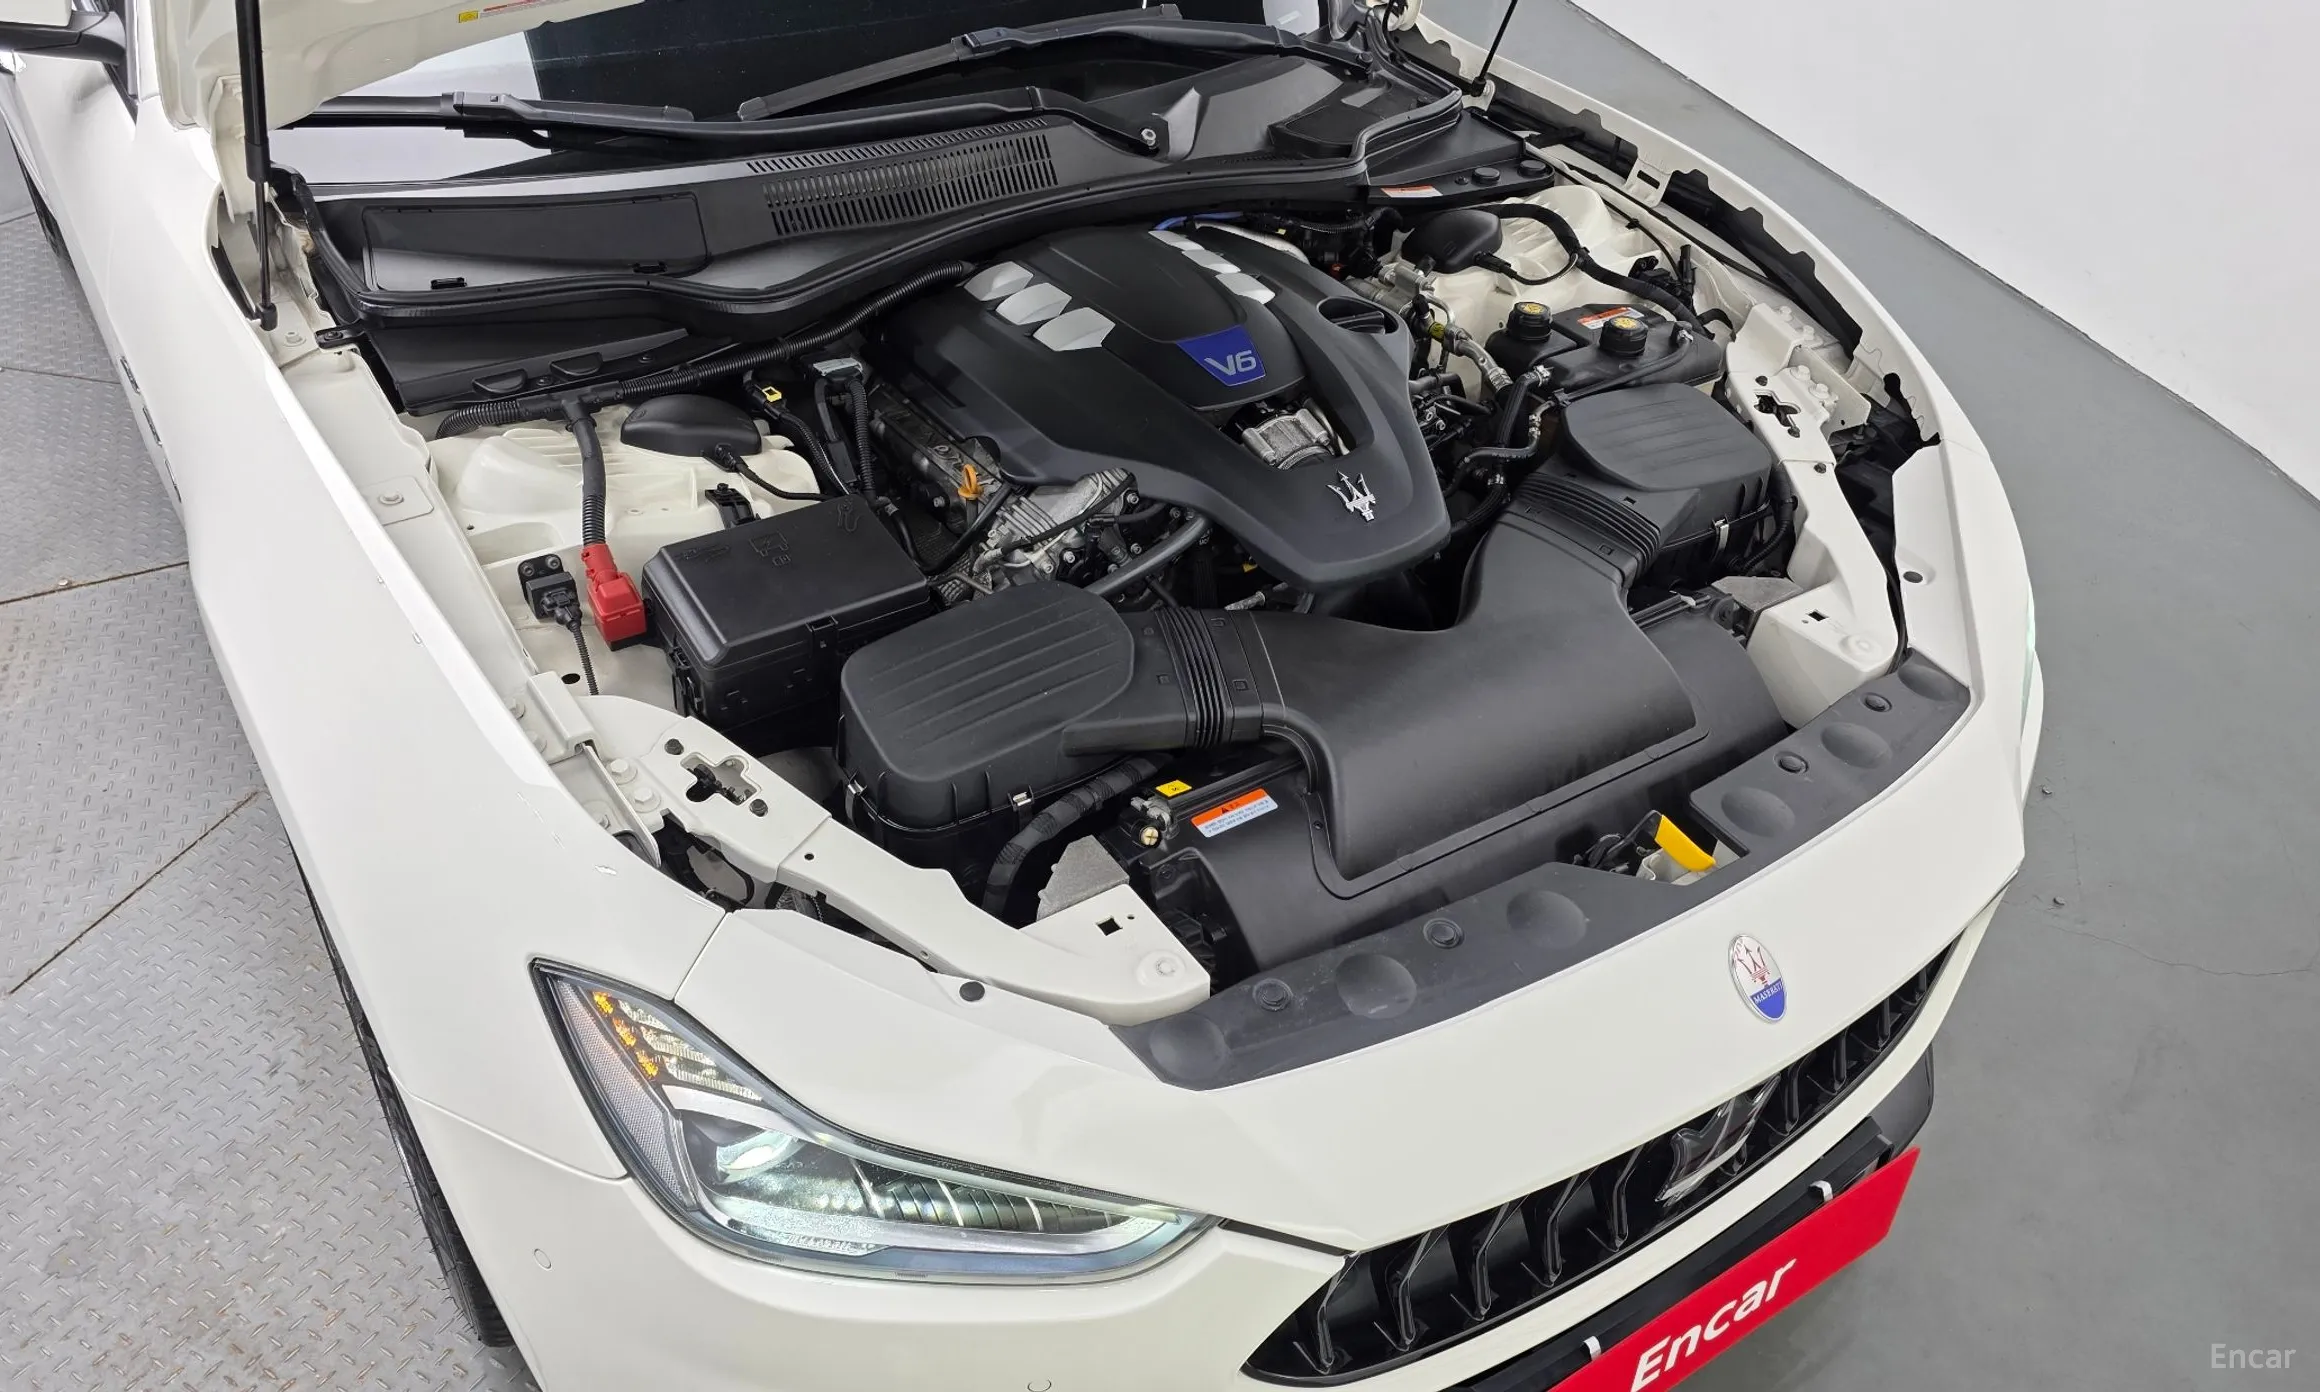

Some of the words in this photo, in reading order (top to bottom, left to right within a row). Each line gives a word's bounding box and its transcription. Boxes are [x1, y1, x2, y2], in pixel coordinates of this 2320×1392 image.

[1204, 350, 1257, 376] V6
[1753, 981, 1783, 1003] MASERATI
[1631, 1258, 1797, 1391] Encar
